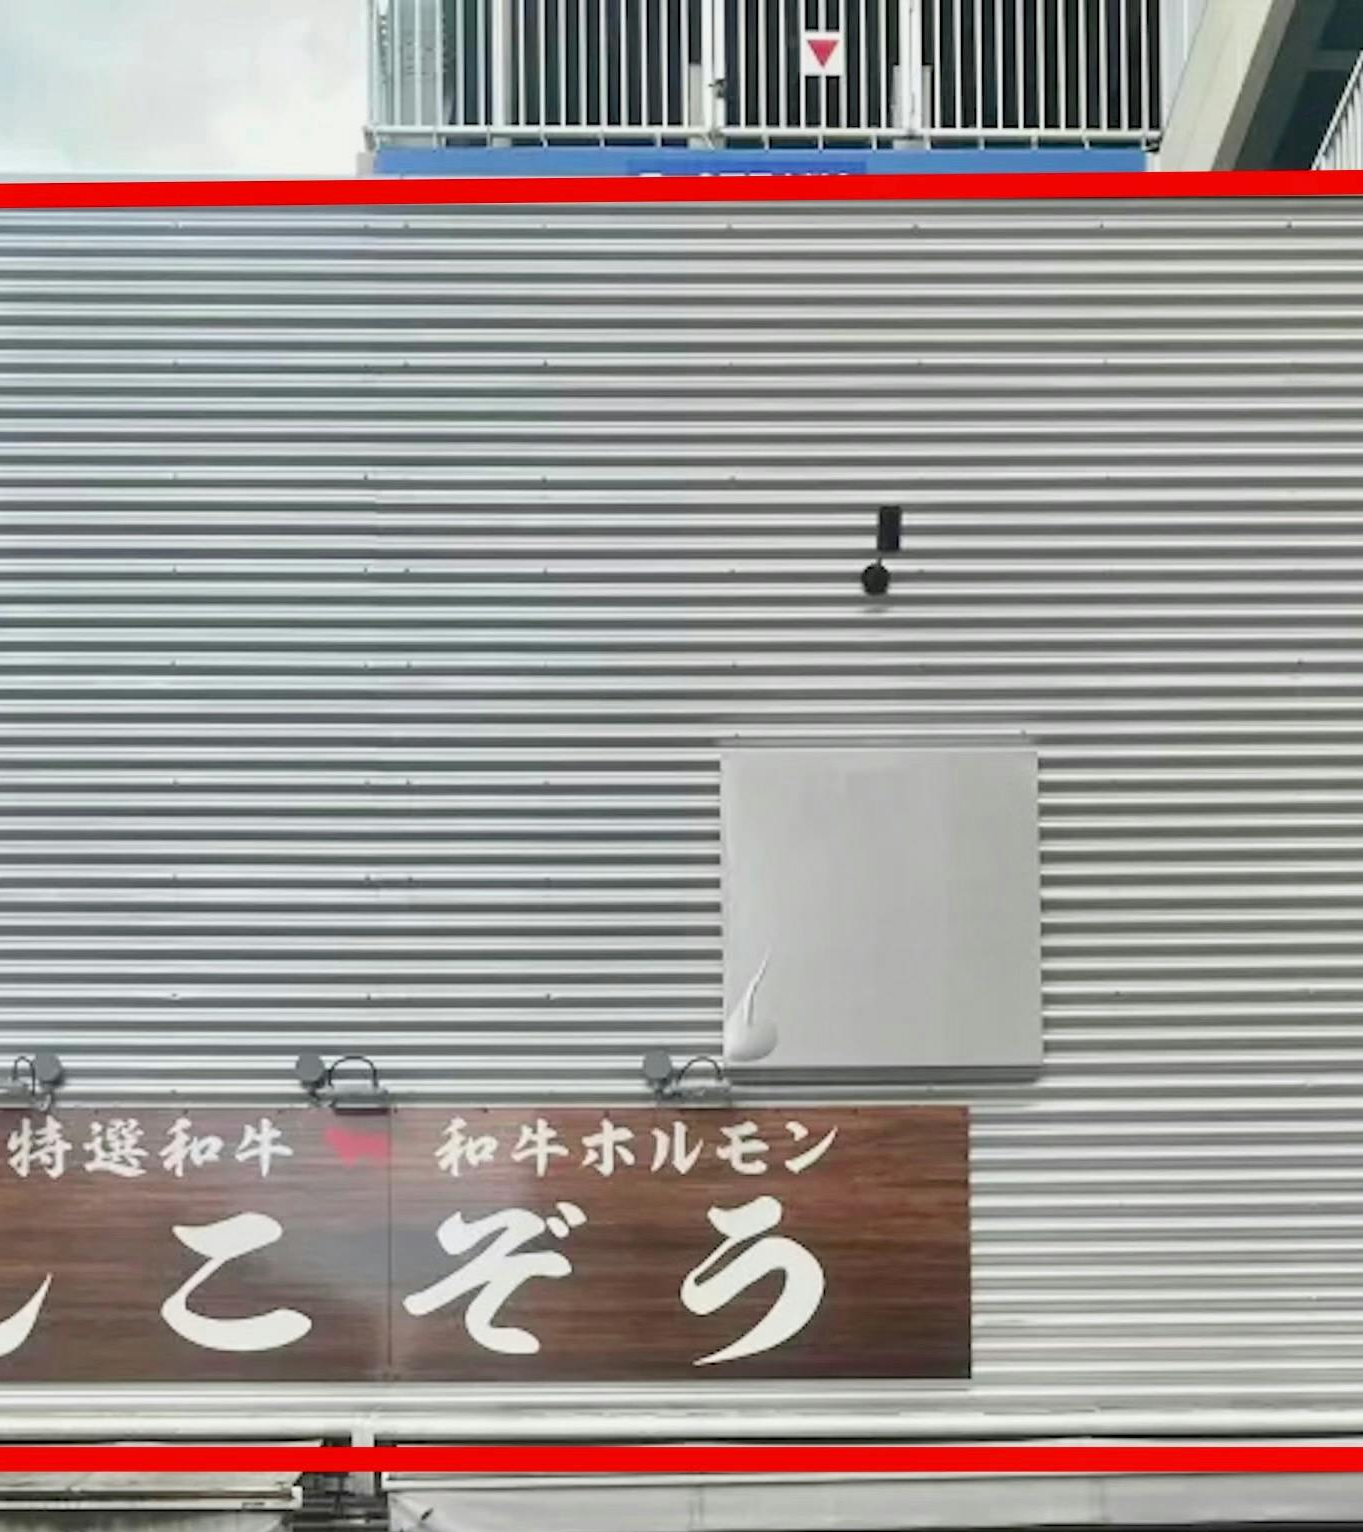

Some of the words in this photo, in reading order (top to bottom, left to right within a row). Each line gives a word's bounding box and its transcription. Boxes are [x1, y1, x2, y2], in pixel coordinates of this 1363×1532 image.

[6, 1116, 294, 1179] 特選和牛
[433, 1117, 837, 1178] 和牛ホルモン
